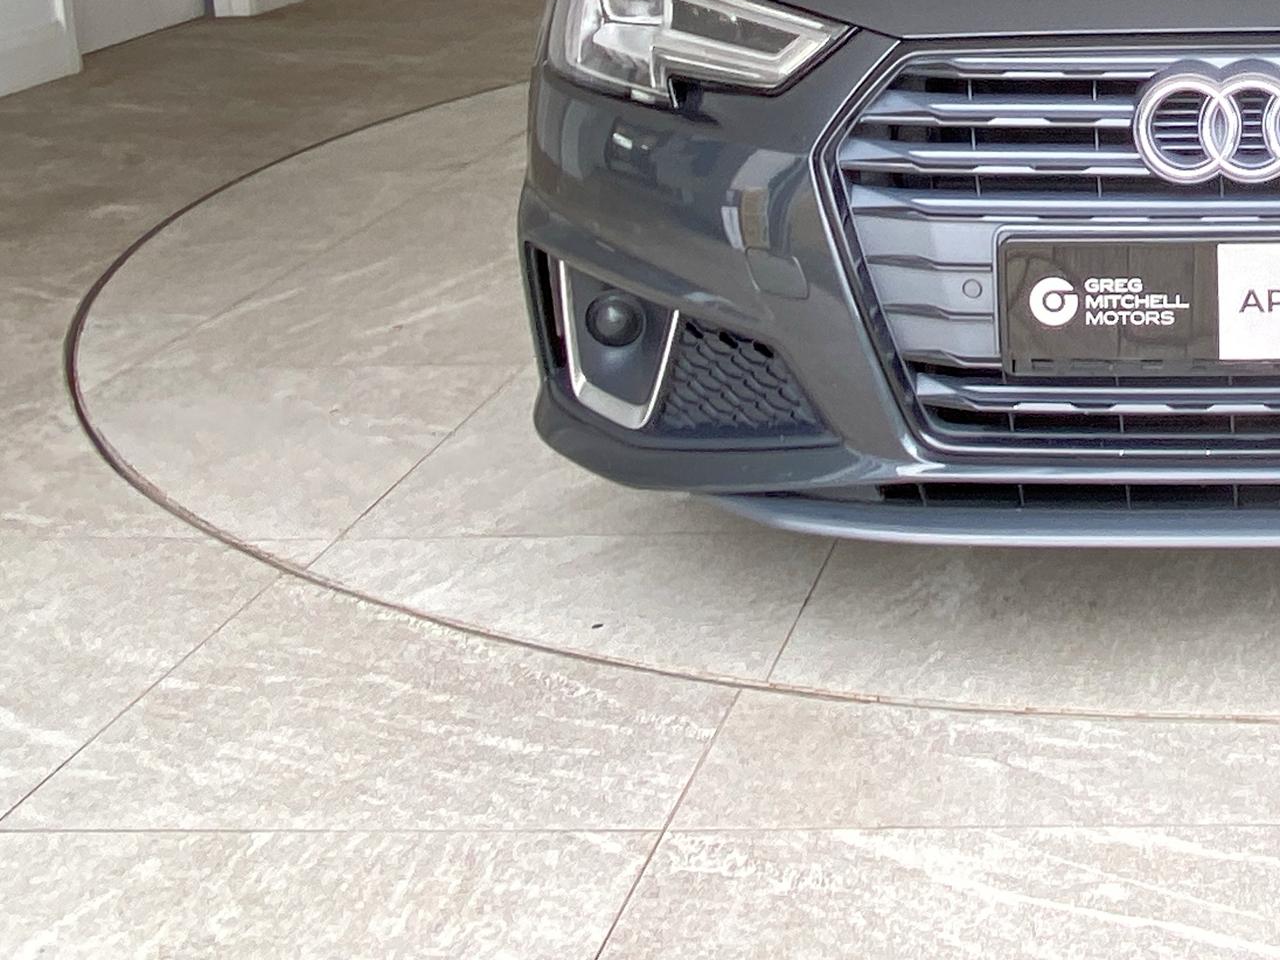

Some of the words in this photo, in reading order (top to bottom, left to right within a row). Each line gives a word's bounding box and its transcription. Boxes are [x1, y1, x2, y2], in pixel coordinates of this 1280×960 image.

[1084, 278, 1143, 292] GREG
[1085, 294, 1189, 310] MITCHELL
[1085, 311, 1175, 325] MOTORS
